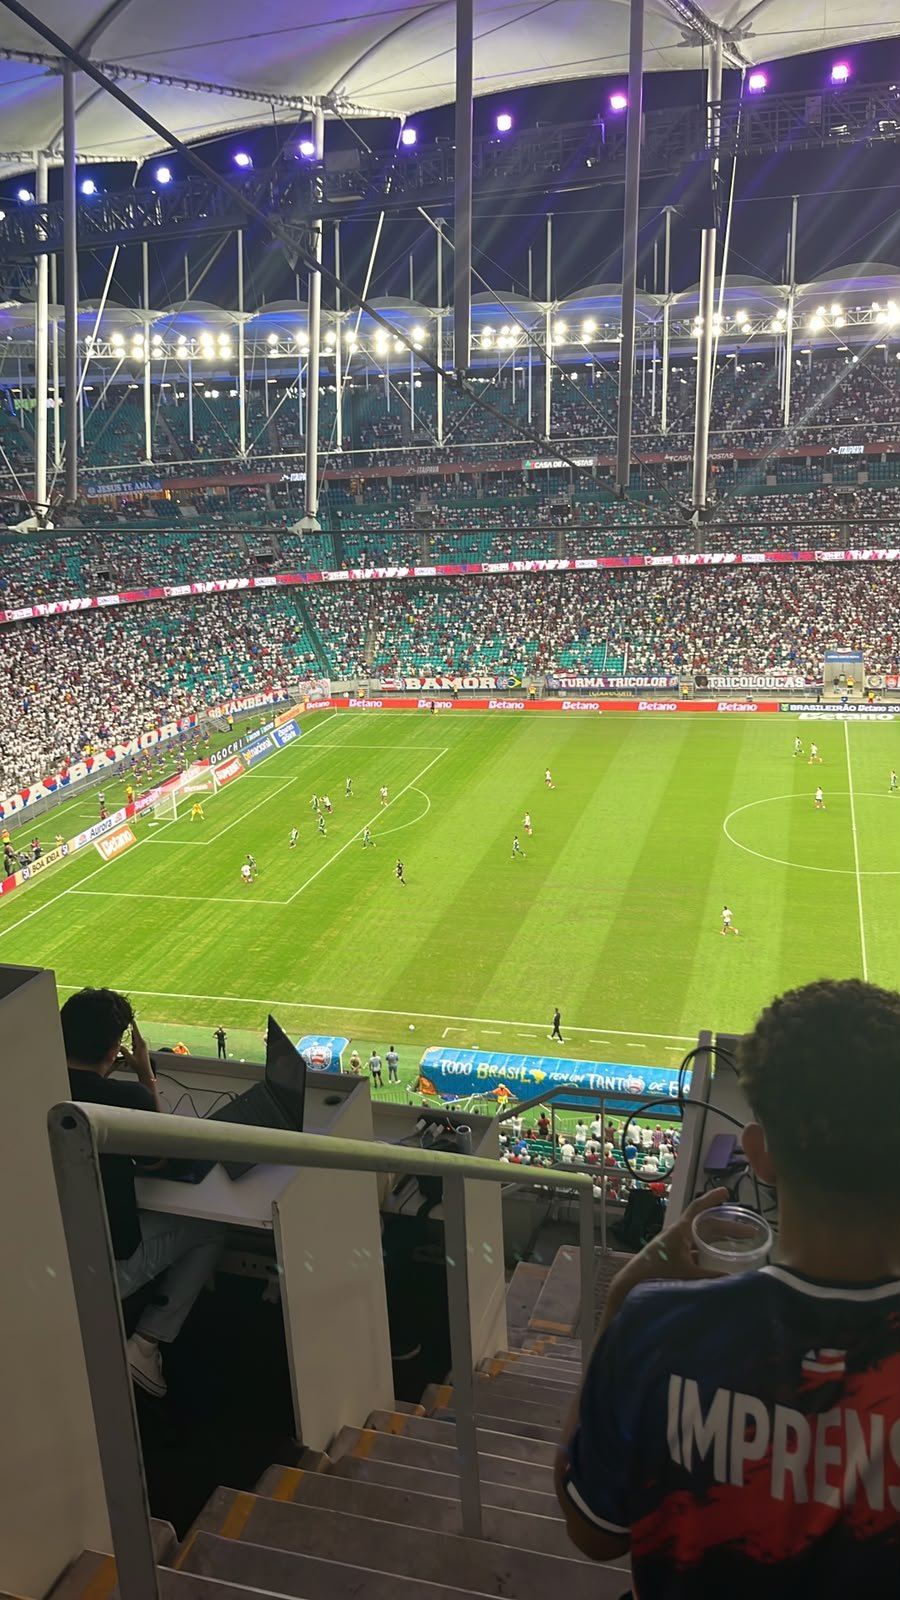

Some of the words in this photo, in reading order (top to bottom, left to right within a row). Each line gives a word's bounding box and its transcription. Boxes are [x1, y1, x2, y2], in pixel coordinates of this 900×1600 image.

[535, 460, 552, 469] CASA
[97, 483, 122, 493] JESUS
[122, 483, 134, 491] TE
[134, 481, 153, 491] AMA
[405, 677, 496, 689] BAMOR
[559, 677, 605, 688] TURMA
[608, 676, 667, 688] TRICOLOR
[708, 675, 805, 688] TRICOLOUCAS
[306, 701, 330, 709] Betano
[349, 699, 382, 708] Betano
[417, 700, 452, 709] Beano
[488, 700, 524, 709] Betano
[562, 701, 599, 710] Betano
[638, 701, 677, 711] Betano
[717, 702, 758, 712] Betano
[790, 704, 856, 712] BRASILEIRÃO
[858, 704, 886, 712] Betano
[69, 724, 178, 779] BAMOR
[210, 739, 242, 764] OGOCHI
[90, 819, 112, 838] Aurora
[101, 830, 133, 857] Betano
[32, 861, 45, 873] BOA
[46, 852, 60, 866] IDEIA
[441, 1060, 473, 1076] TODO
[477, 1062, 531, 1083] BRASIL
[666, 1373, 900, 1513] IMPREN
